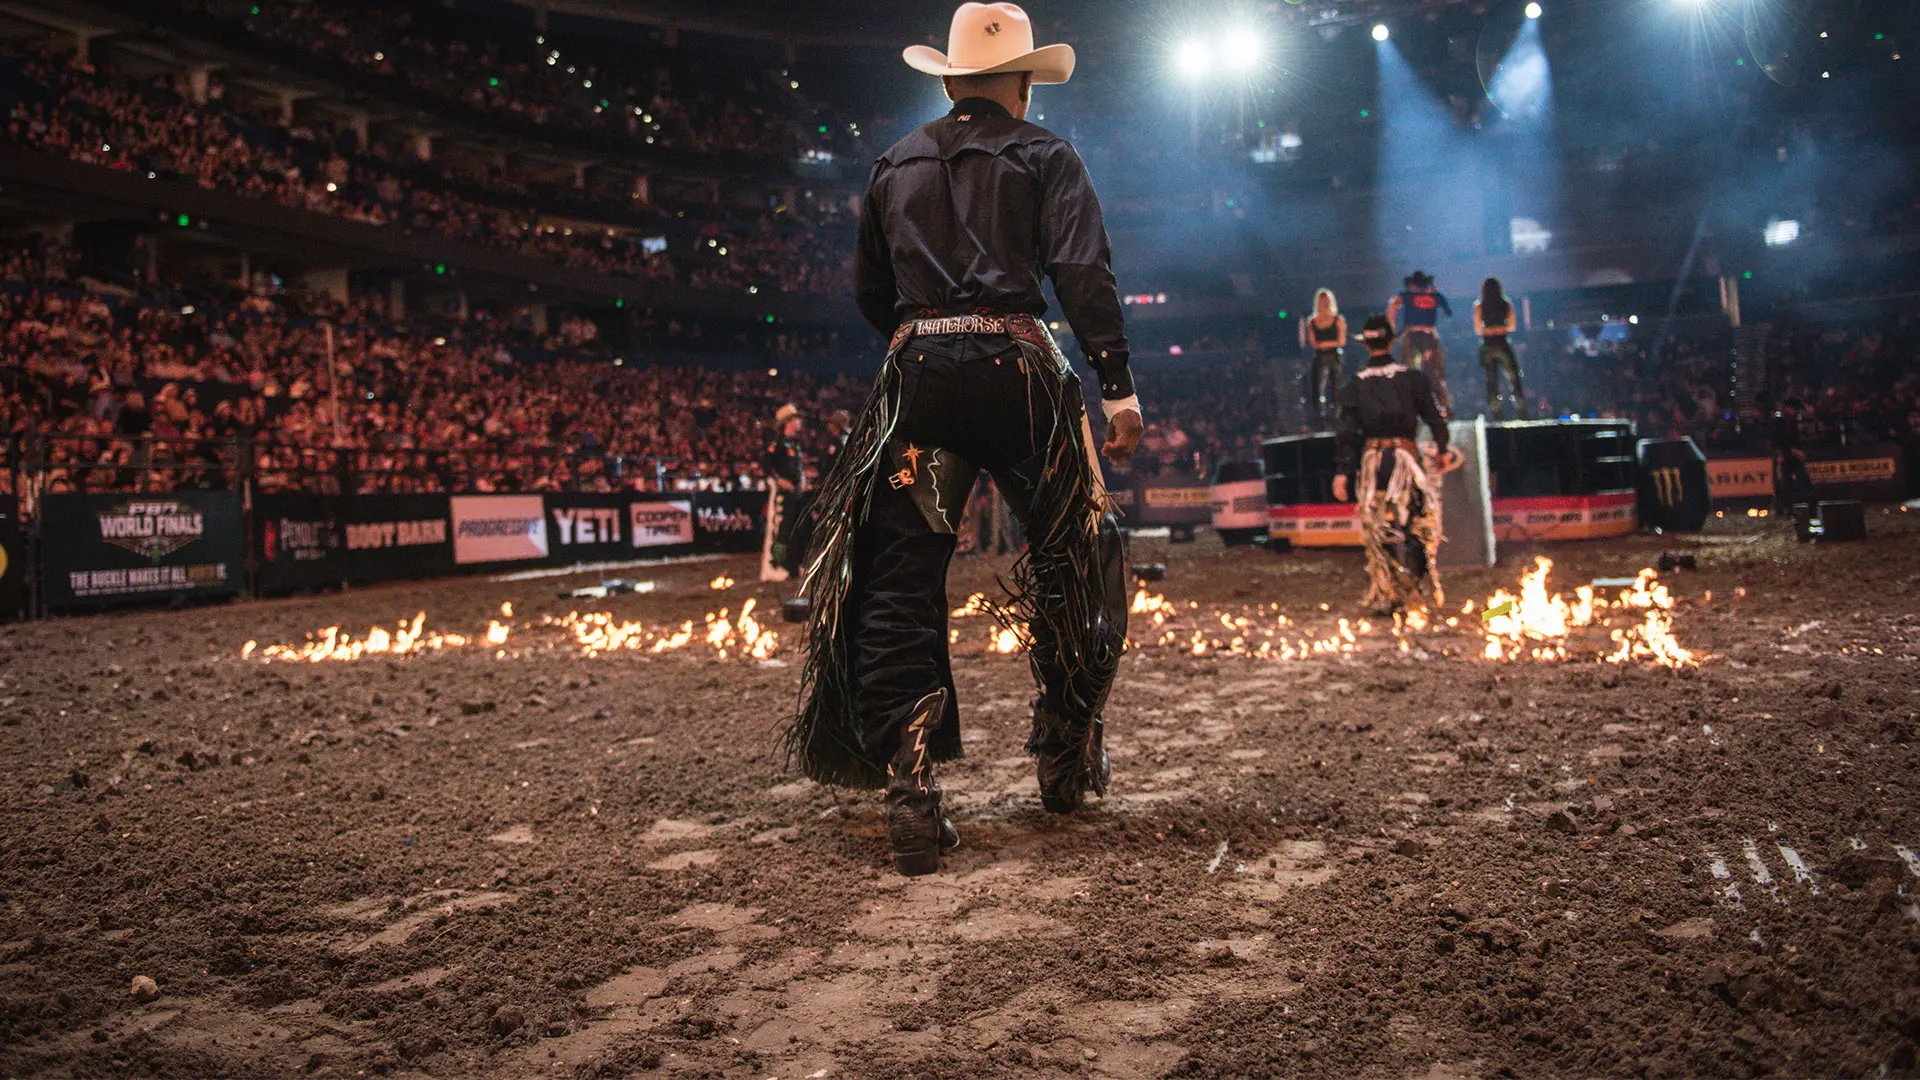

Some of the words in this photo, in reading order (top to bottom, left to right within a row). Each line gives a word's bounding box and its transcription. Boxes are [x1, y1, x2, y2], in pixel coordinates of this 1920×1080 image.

[917, 315, 1004, 335] WHITEHORSE
[100, 516, 153, 537] WORLD
[157, 514, 202, 536] FINALS
[458, 517, 540, 537] PROGRESSIVE
[552, 507, 621, 544] YETI
[636, 510, 688, 524] COOPER
[346, 524, 395, 549] BOOT
[397, 519, 446, 545] BARN
[70, 572, 89, 588] THE
[92, 570, 127, 587] BUCKLE
